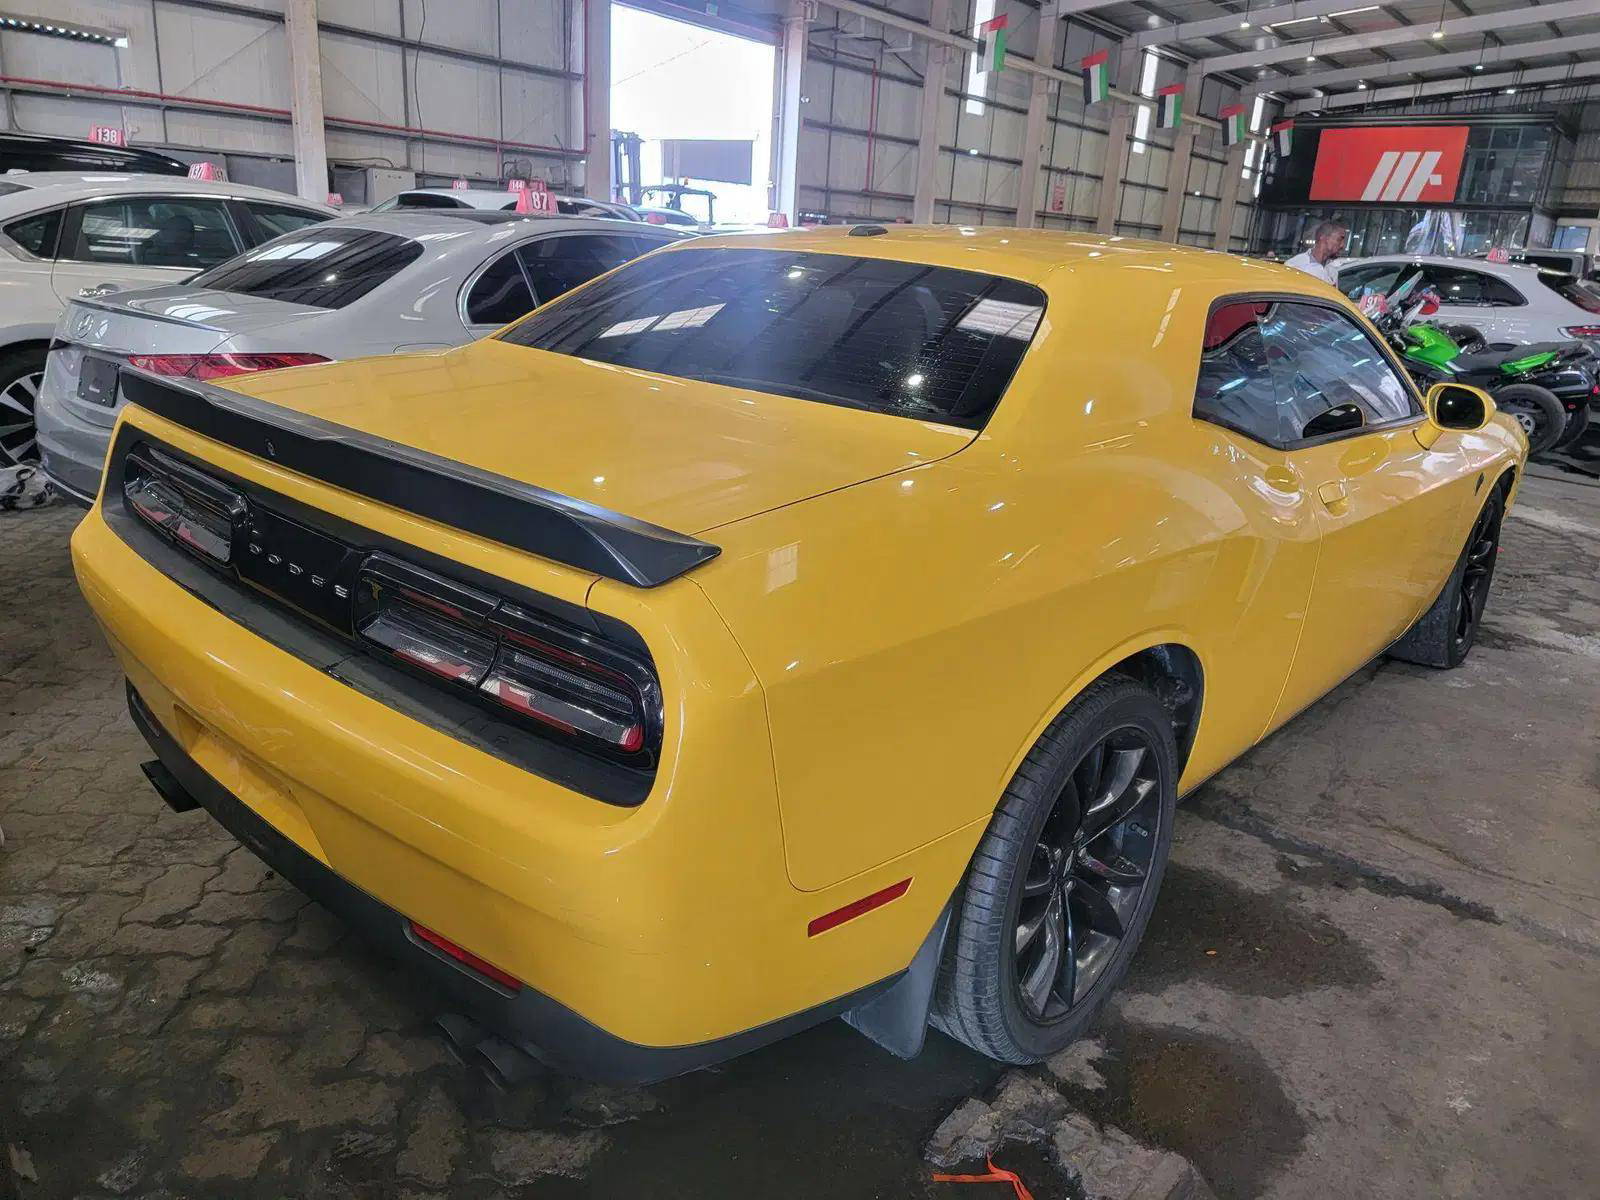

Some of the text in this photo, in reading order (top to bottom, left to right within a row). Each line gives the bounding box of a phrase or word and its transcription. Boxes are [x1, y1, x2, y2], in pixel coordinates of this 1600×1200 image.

[97, 128, 117, 143] 138
[531, 191, 548, 210] 87
[248, 542, 349, 599] DODGE
